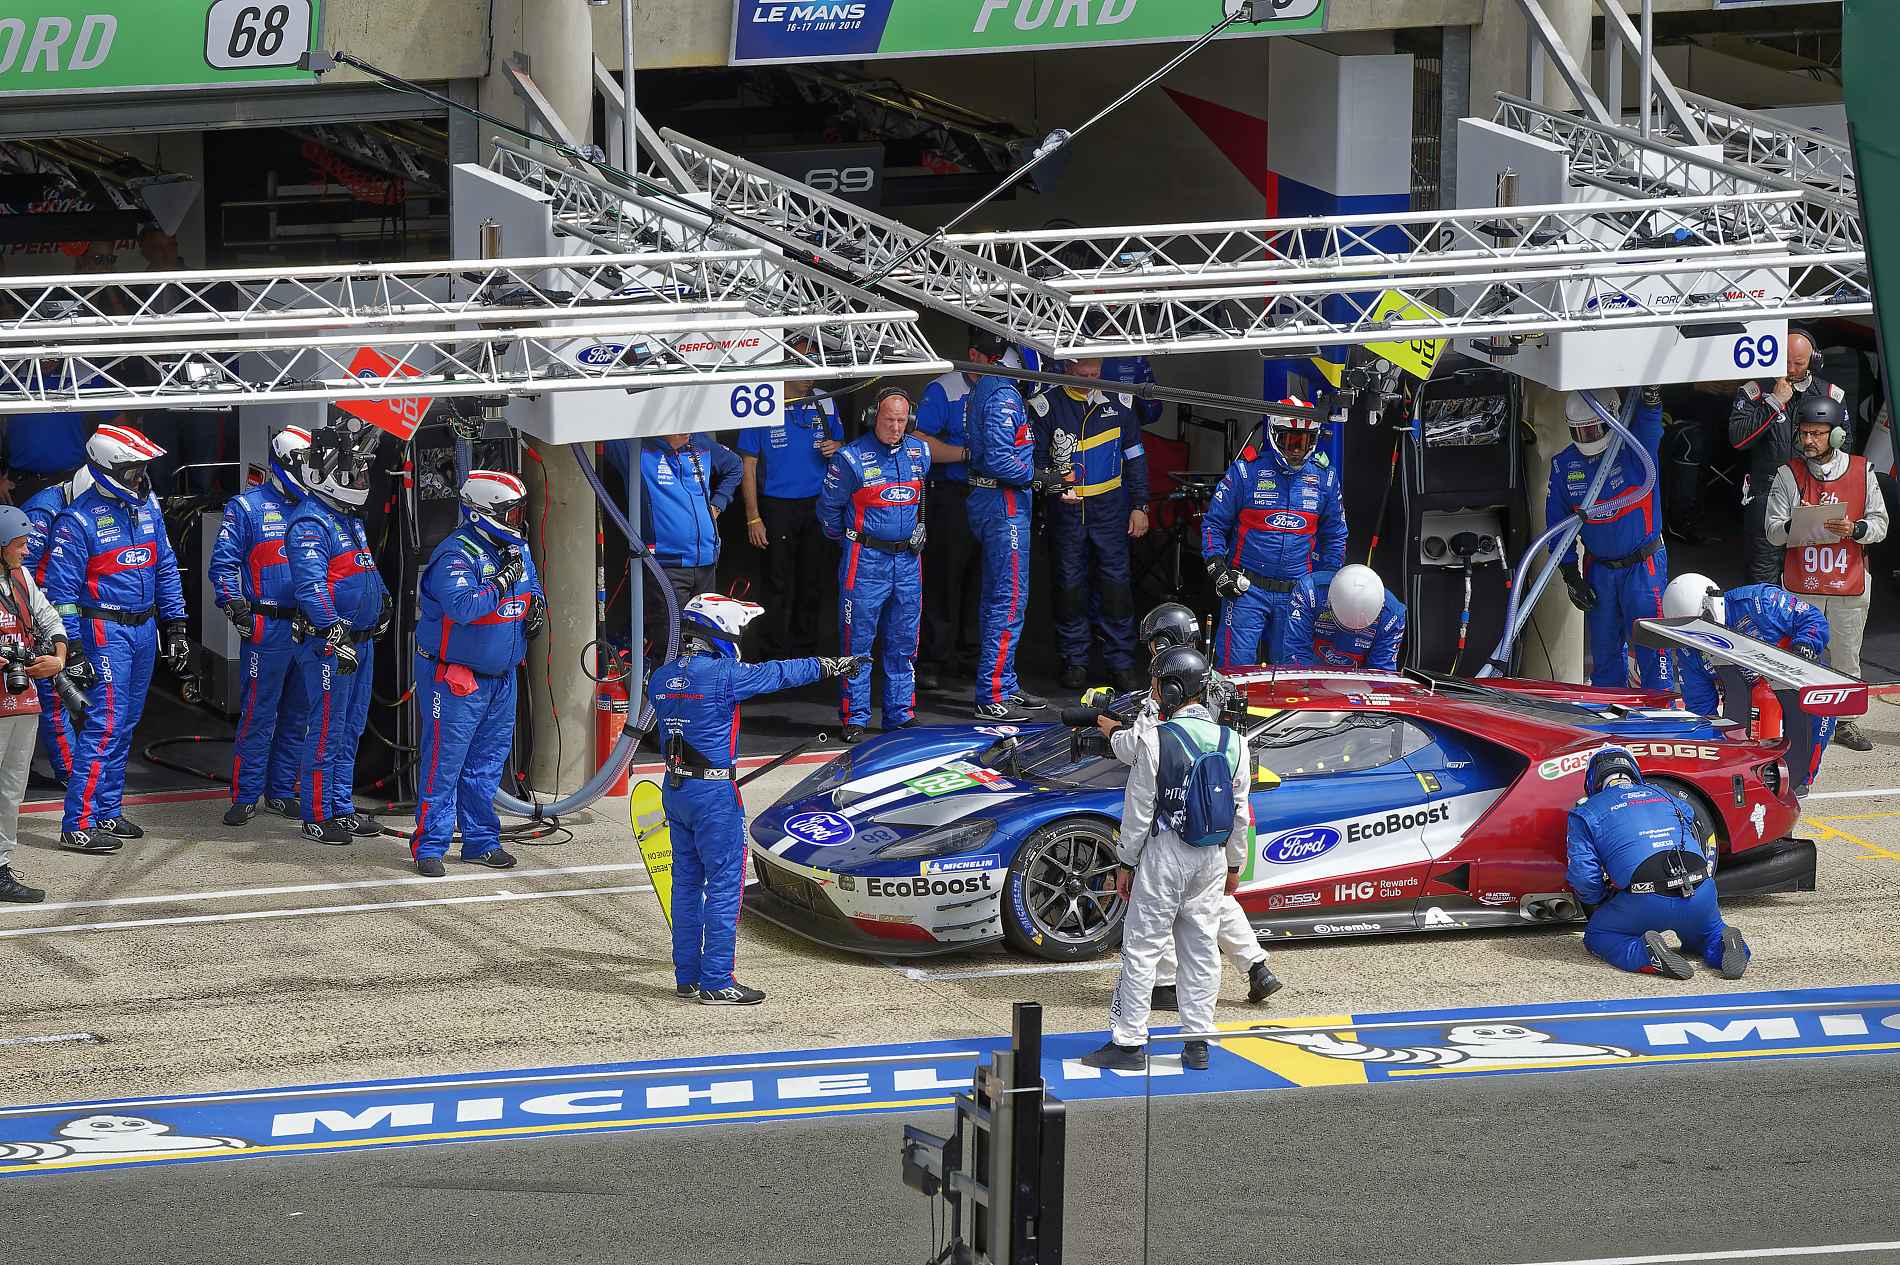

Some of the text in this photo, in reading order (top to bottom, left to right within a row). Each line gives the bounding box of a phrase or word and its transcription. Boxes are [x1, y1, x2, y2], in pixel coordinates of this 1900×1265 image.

[752, 4, 866, 23] LE MANS
[786, 20, 861, 32] 16-17 JUIN 2018
[227, 4, 290, 58] 68
[804, 166, 874, 193] 69
[1732, 334, 1778, 369] 69
[730, 384, 775, 418] 68
[888, 488, 911, 500] Ford
[1272, 514, 1300, 528] Ford
[1009, 524, 1019, 550] FORD
[125, 551, 147, 564] Ford
[1804, 547, 1849, 574] 904
[100, 656, 113, 682] FORD
[249, 651, 259, 679] FORD
[322, 663, 331, 691] FORD
[1660, 656, 1668, 681] FORD
[431, 690, 441, 719] FORD
[1803, 687, 1866, 705] GT
[1627, 743, 1721, 761] EDGE
[790, 814, 844, 841] Ford
[1346, 802, 1450, 845] EcoBoost
[1278, 832, 1327, 861] Ford
[942, 859, 993, 870] MICHELIN
[866, 872, 992, 897] EcoBoost
[1334, 876, 1418, 902] IHG Rewards
[1380, 888, 1402, 898] Club
[1331, 923, 1381, 933] brembo
